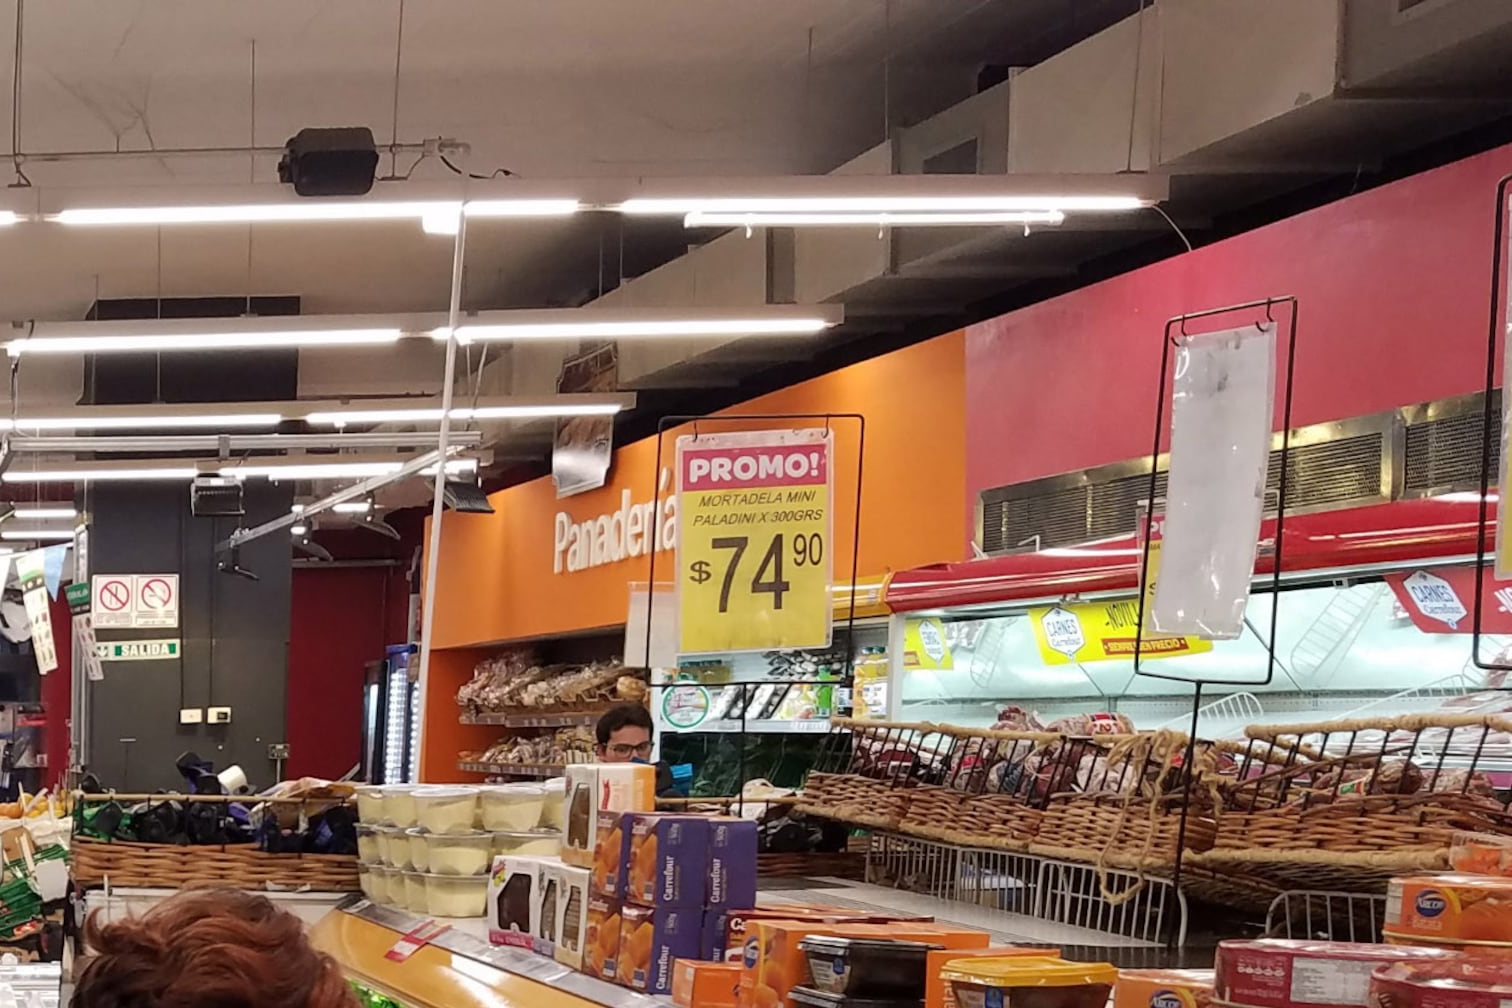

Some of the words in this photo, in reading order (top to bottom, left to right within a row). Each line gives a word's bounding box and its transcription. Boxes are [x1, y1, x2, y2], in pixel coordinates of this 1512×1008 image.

[689, 452, 820, 484] PROMO!
[693, 513, 757, 527] PALADINI
[758, 512, 768, 524] X
[770, 508, 824, 524] 300GRS
[698, 491, 784, 508] MORTADELA
[786, 490, 817, 503] MINI
[553, 466, 678, 575] Panadería
[121, 643, 170, 657] SALIDA
[663, 855, 675, 901] Carrefour
[710, 858, 722, 903] Carrefour
[656, 945, 670, 990] Carrefour
